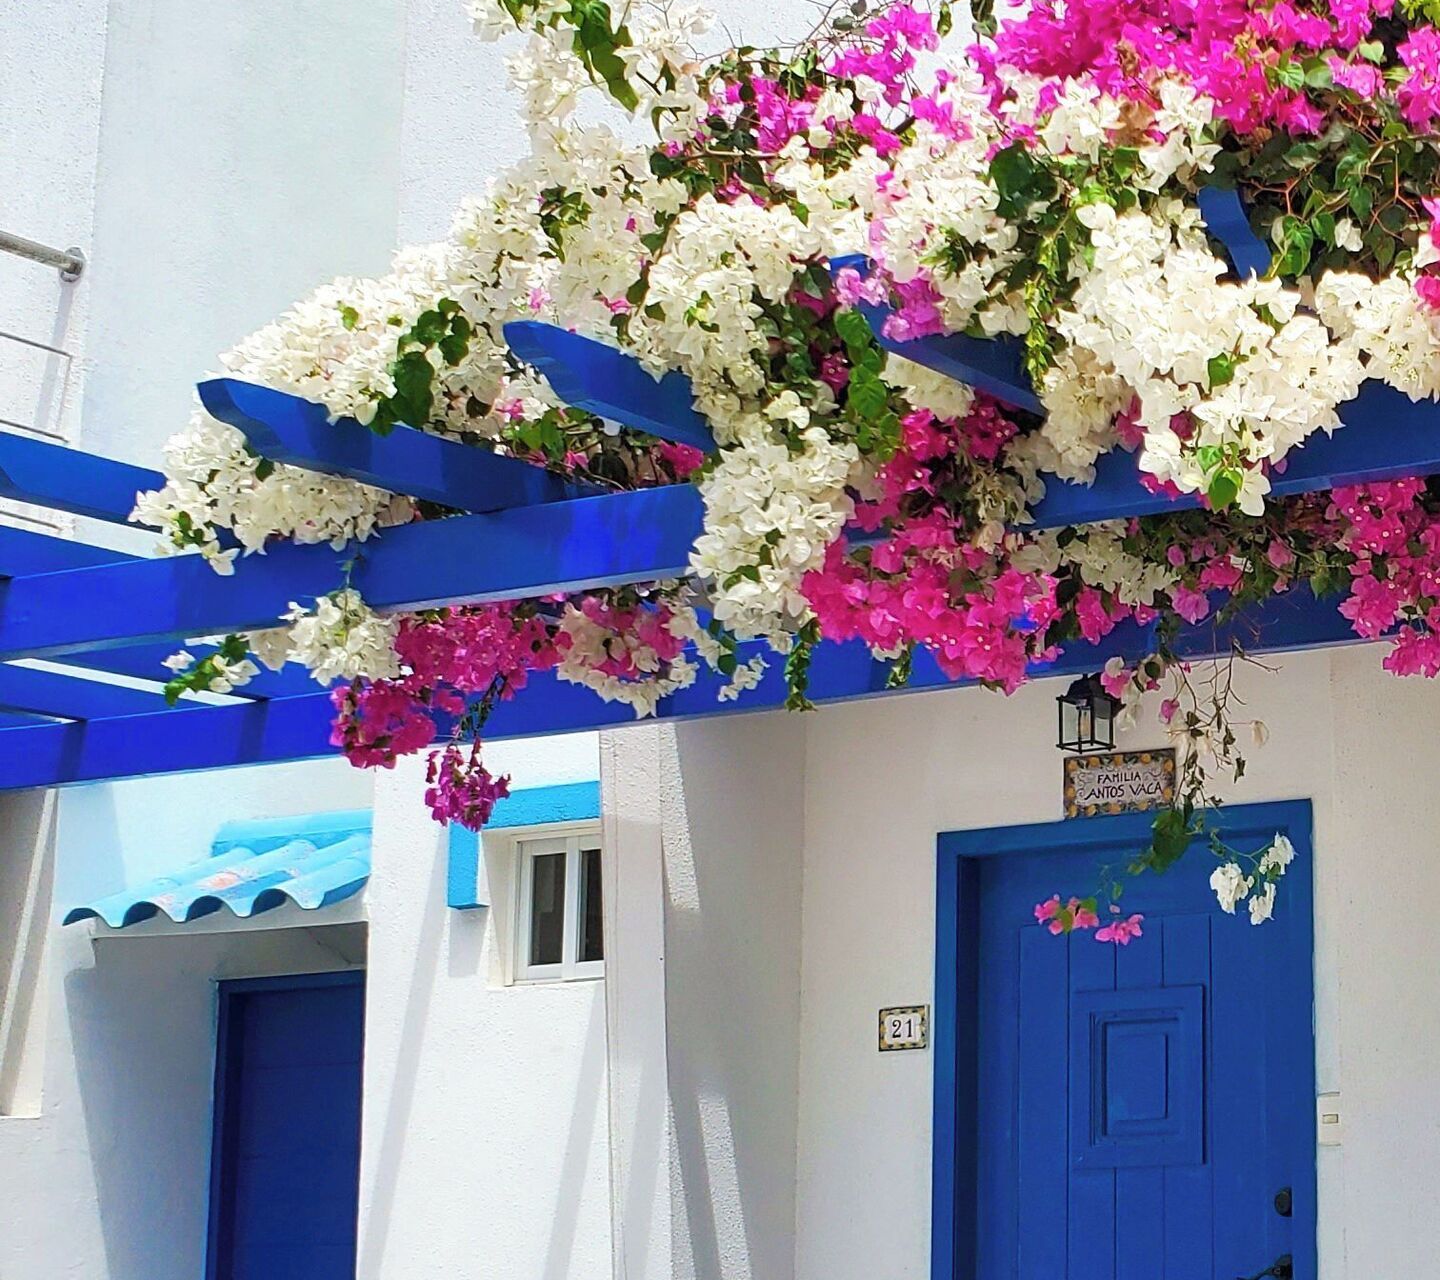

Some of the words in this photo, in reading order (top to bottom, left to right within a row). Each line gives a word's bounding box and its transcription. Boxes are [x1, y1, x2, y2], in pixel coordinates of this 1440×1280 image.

[1097, 771, 1141, 784] FAMILIA
[1129, 781, 1163, 796] VACA
[892, 1018, 913, 1038] 21
